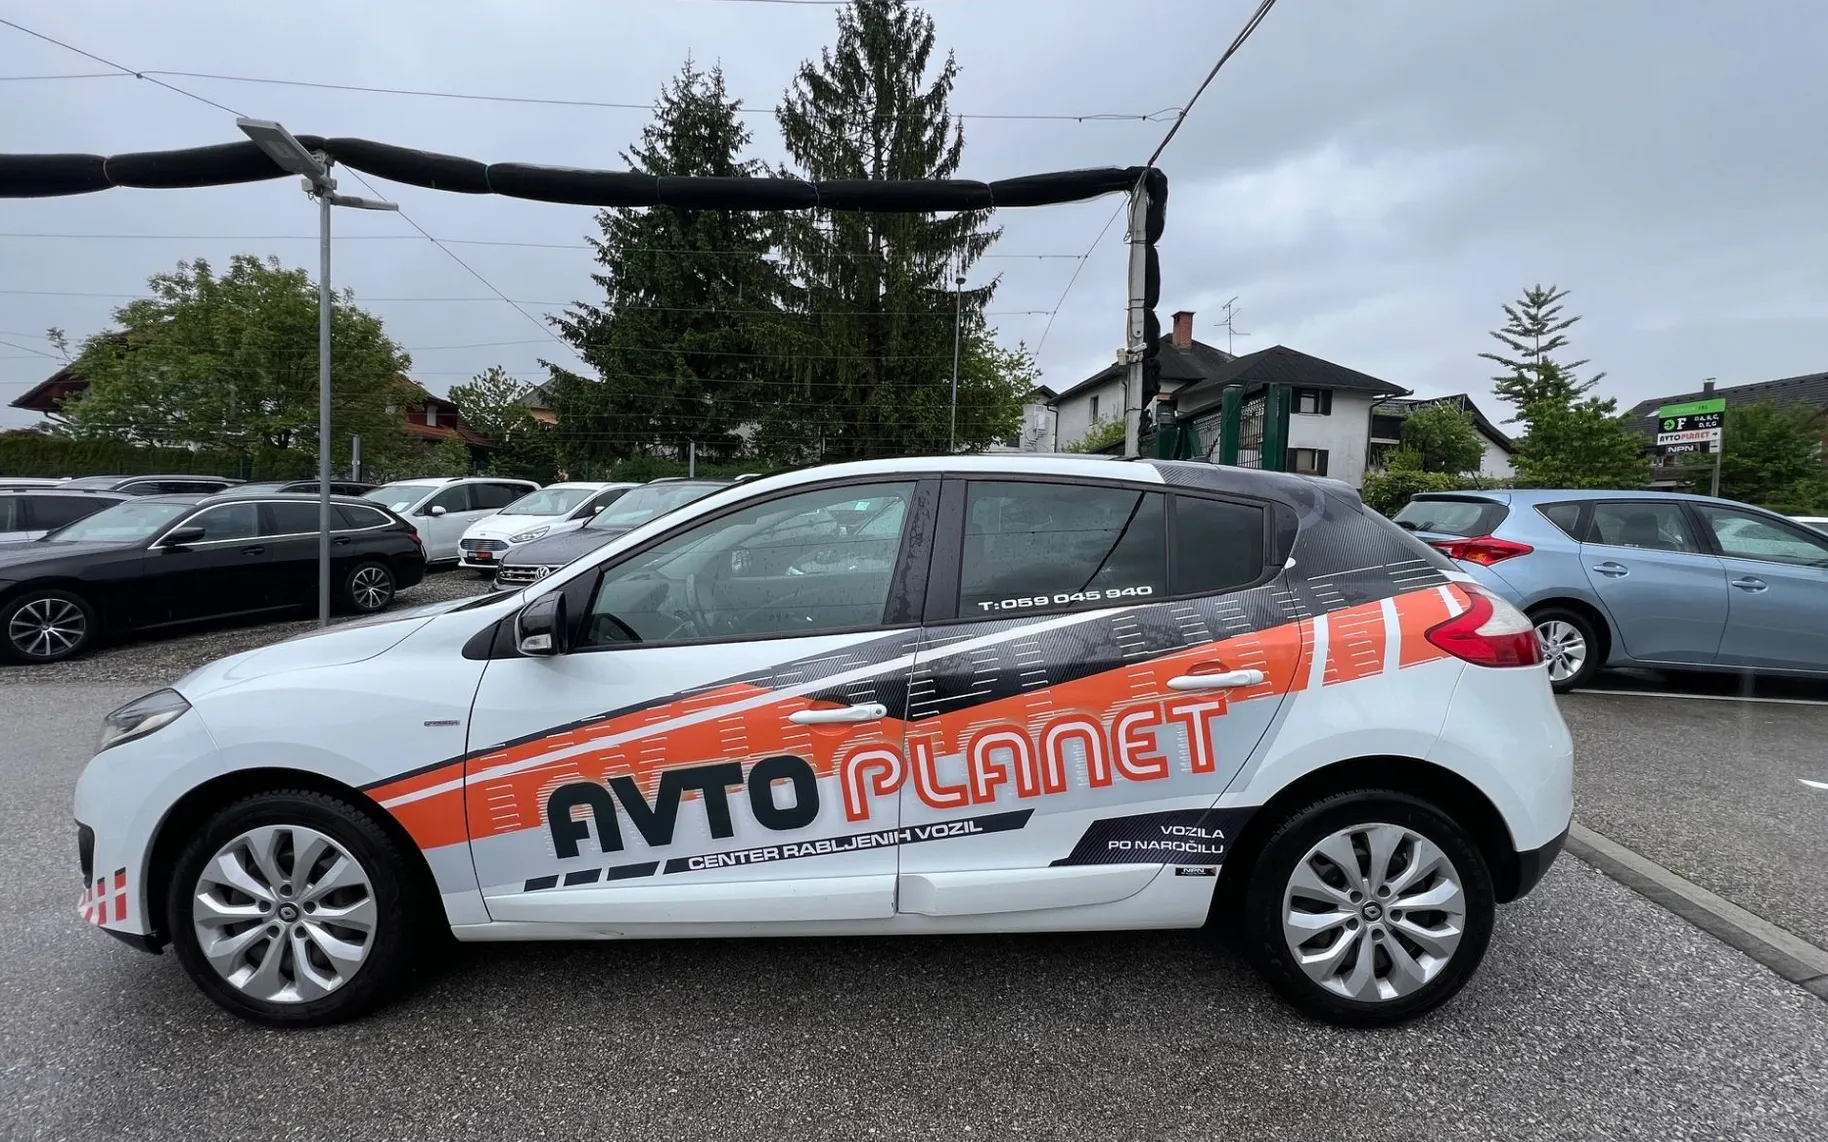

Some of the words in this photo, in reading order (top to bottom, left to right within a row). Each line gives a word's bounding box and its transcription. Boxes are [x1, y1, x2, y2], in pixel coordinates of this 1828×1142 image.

[1668, 445, 1694, 453] NPN
[978, 596, 1050, 611] T:059
[1053, 590, 1101, 604] 045
[1105, 585, 1153, 599] 940
[1160, 825, 1225, 839] VOZILA
[688, 847, 780, 870] CENTER
[783, 829, 912, 859] RABLJENIH
[915, 820, 983, 839] VOZIL
[1108, 840, 1132, 850] PO
[1134, 839, 1224, 854] NAROČILU
